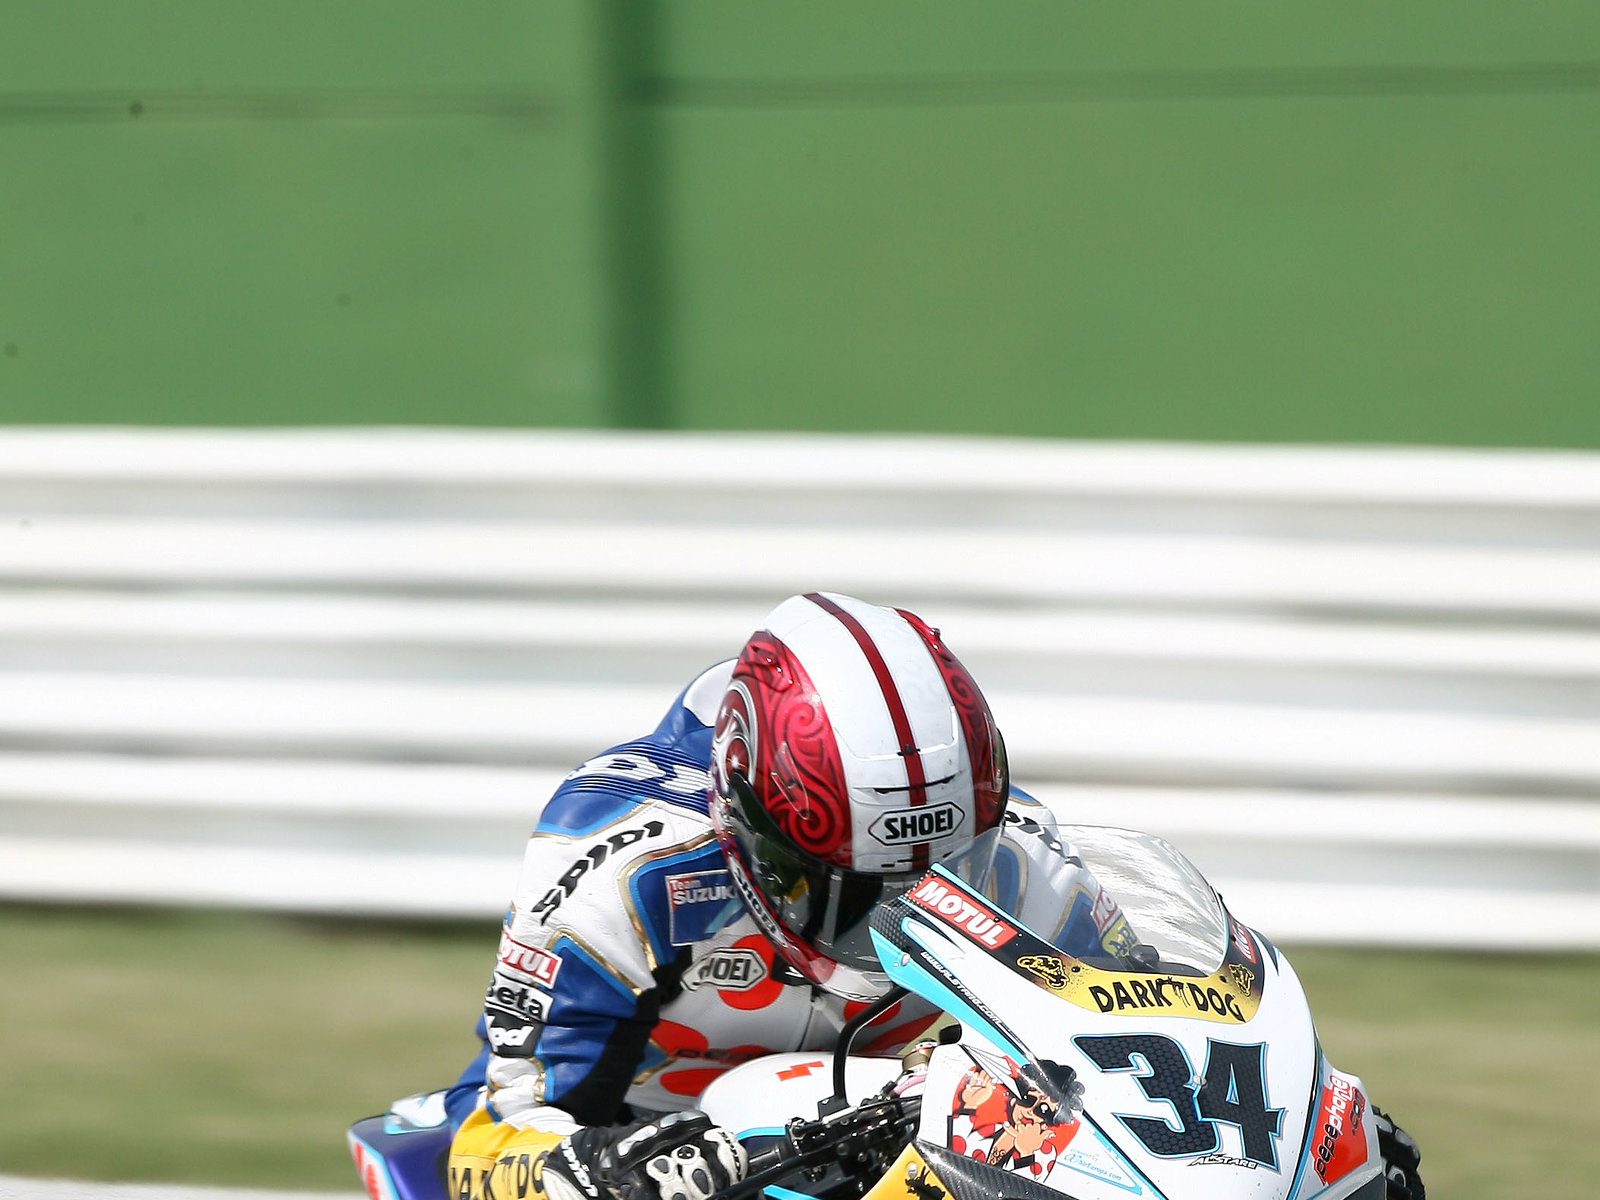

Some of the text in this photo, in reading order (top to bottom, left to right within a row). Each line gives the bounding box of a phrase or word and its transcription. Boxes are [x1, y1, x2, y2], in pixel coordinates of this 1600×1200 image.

[884, 808, 954, 841] SHOEI
[531, 820, 664, 926] SPIDI
[669, 879, 702, 890] Team
[672, 884, 739, 906] SUZUK
[918, 880, 1004, 946] MOTUL
[1088, 978, 1245, 1022] DARK DOG
[1070, 1033, 1288, 1171] 34
